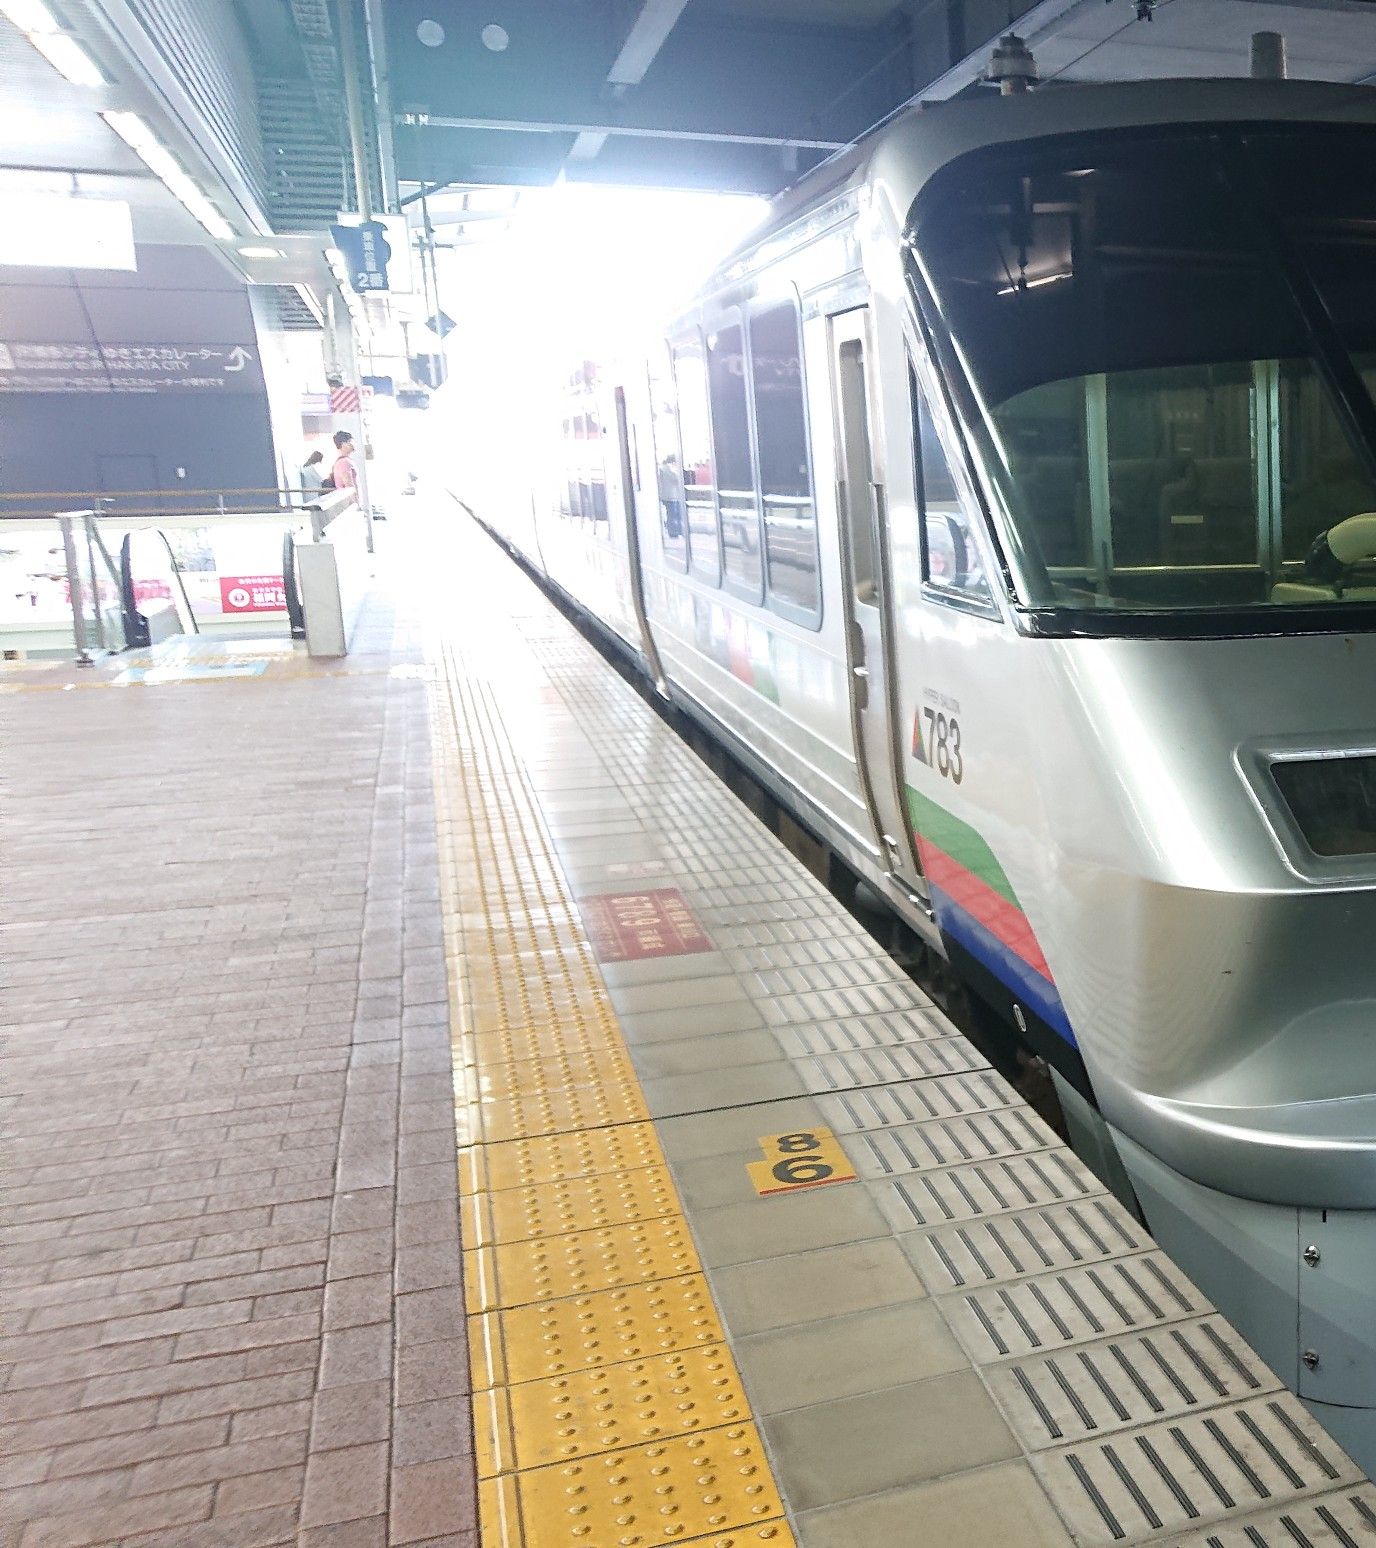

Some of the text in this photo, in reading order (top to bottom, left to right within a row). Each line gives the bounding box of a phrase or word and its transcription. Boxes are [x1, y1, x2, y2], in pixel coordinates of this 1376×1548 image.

[923, 706, 963, 786] 783
[776, 1132, 821, 1153] 8
[772, 1155, 834, 1184] 6
